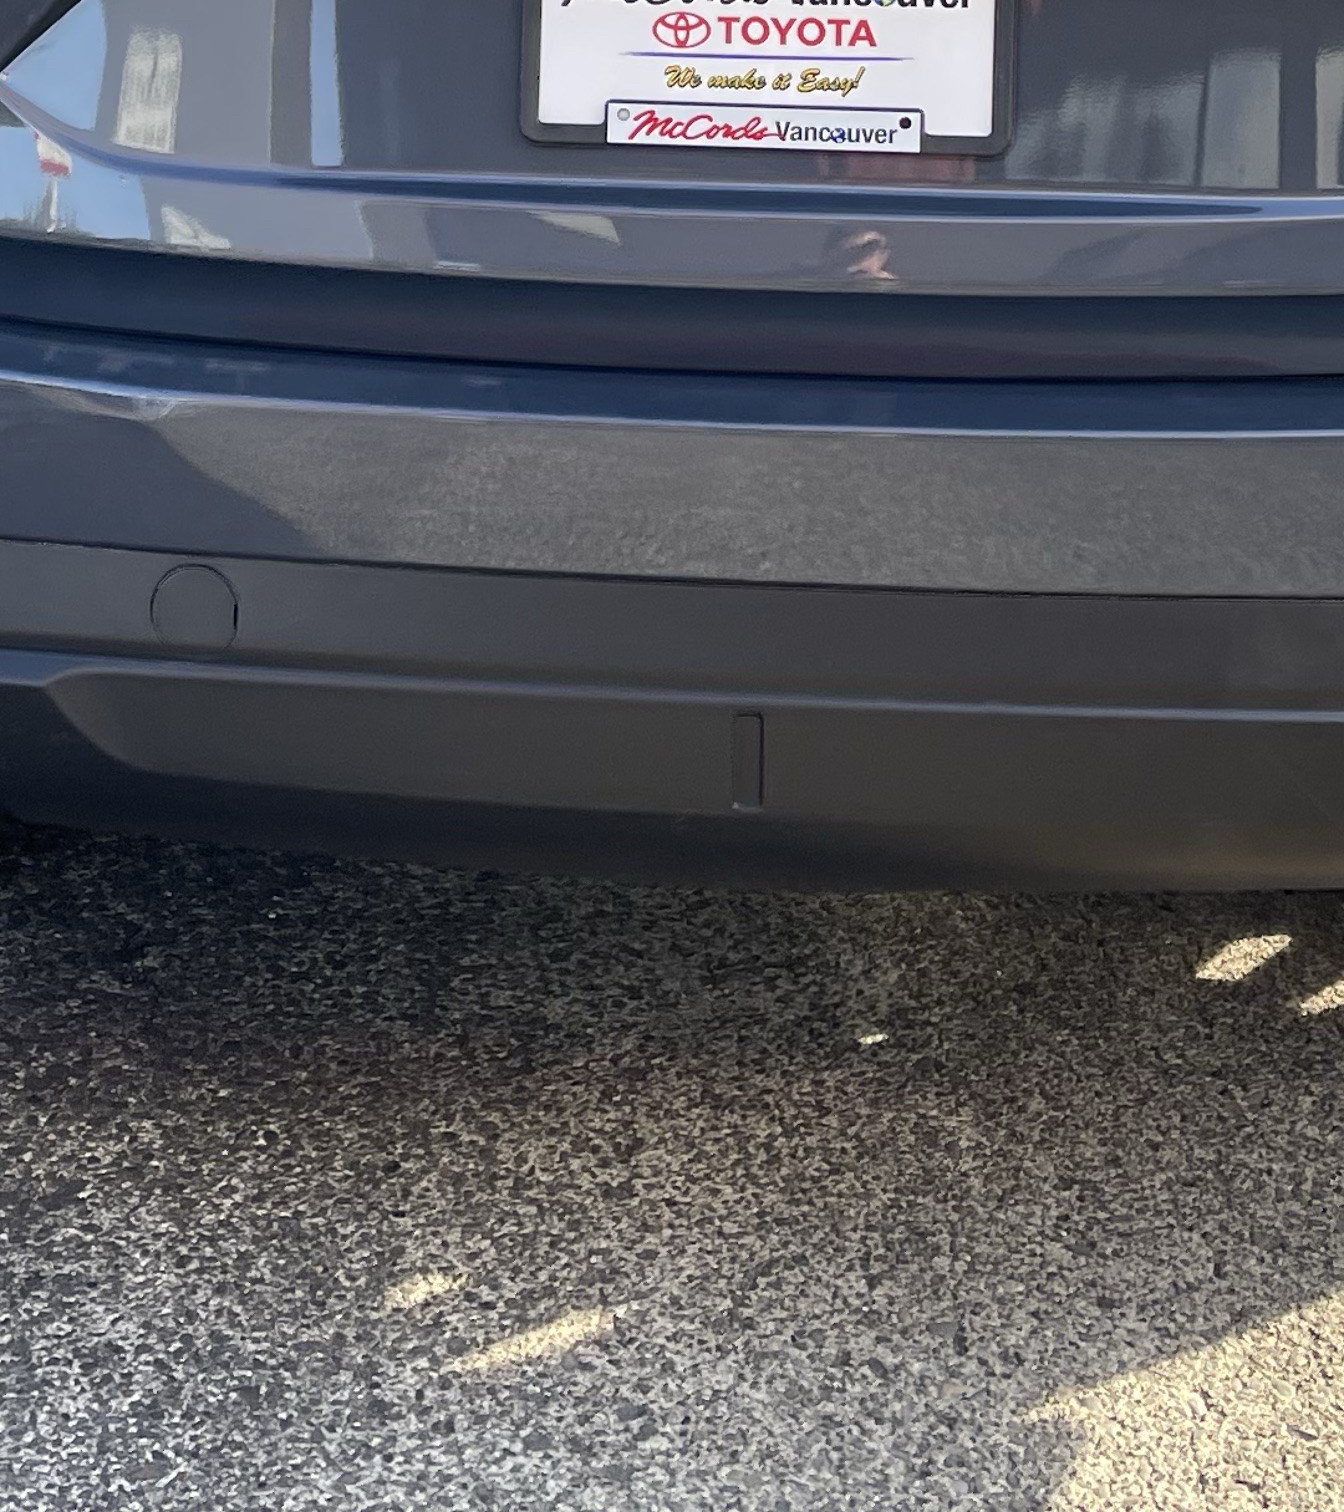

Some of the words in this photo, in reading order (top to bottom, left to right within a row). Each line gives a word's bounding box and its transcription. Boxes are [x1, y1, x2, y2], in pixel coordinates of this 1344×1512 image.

[718, 16, 877, 48] TOYOTA
[663, 64, 702, 88] We
[707, 67, 766, 90] make
[772, 69, 792, 90] it
[797, 66, 866, 98] Easy!
[627, 109, 784, 141] McCords
[775, 121, 898, 145] Vancouver
